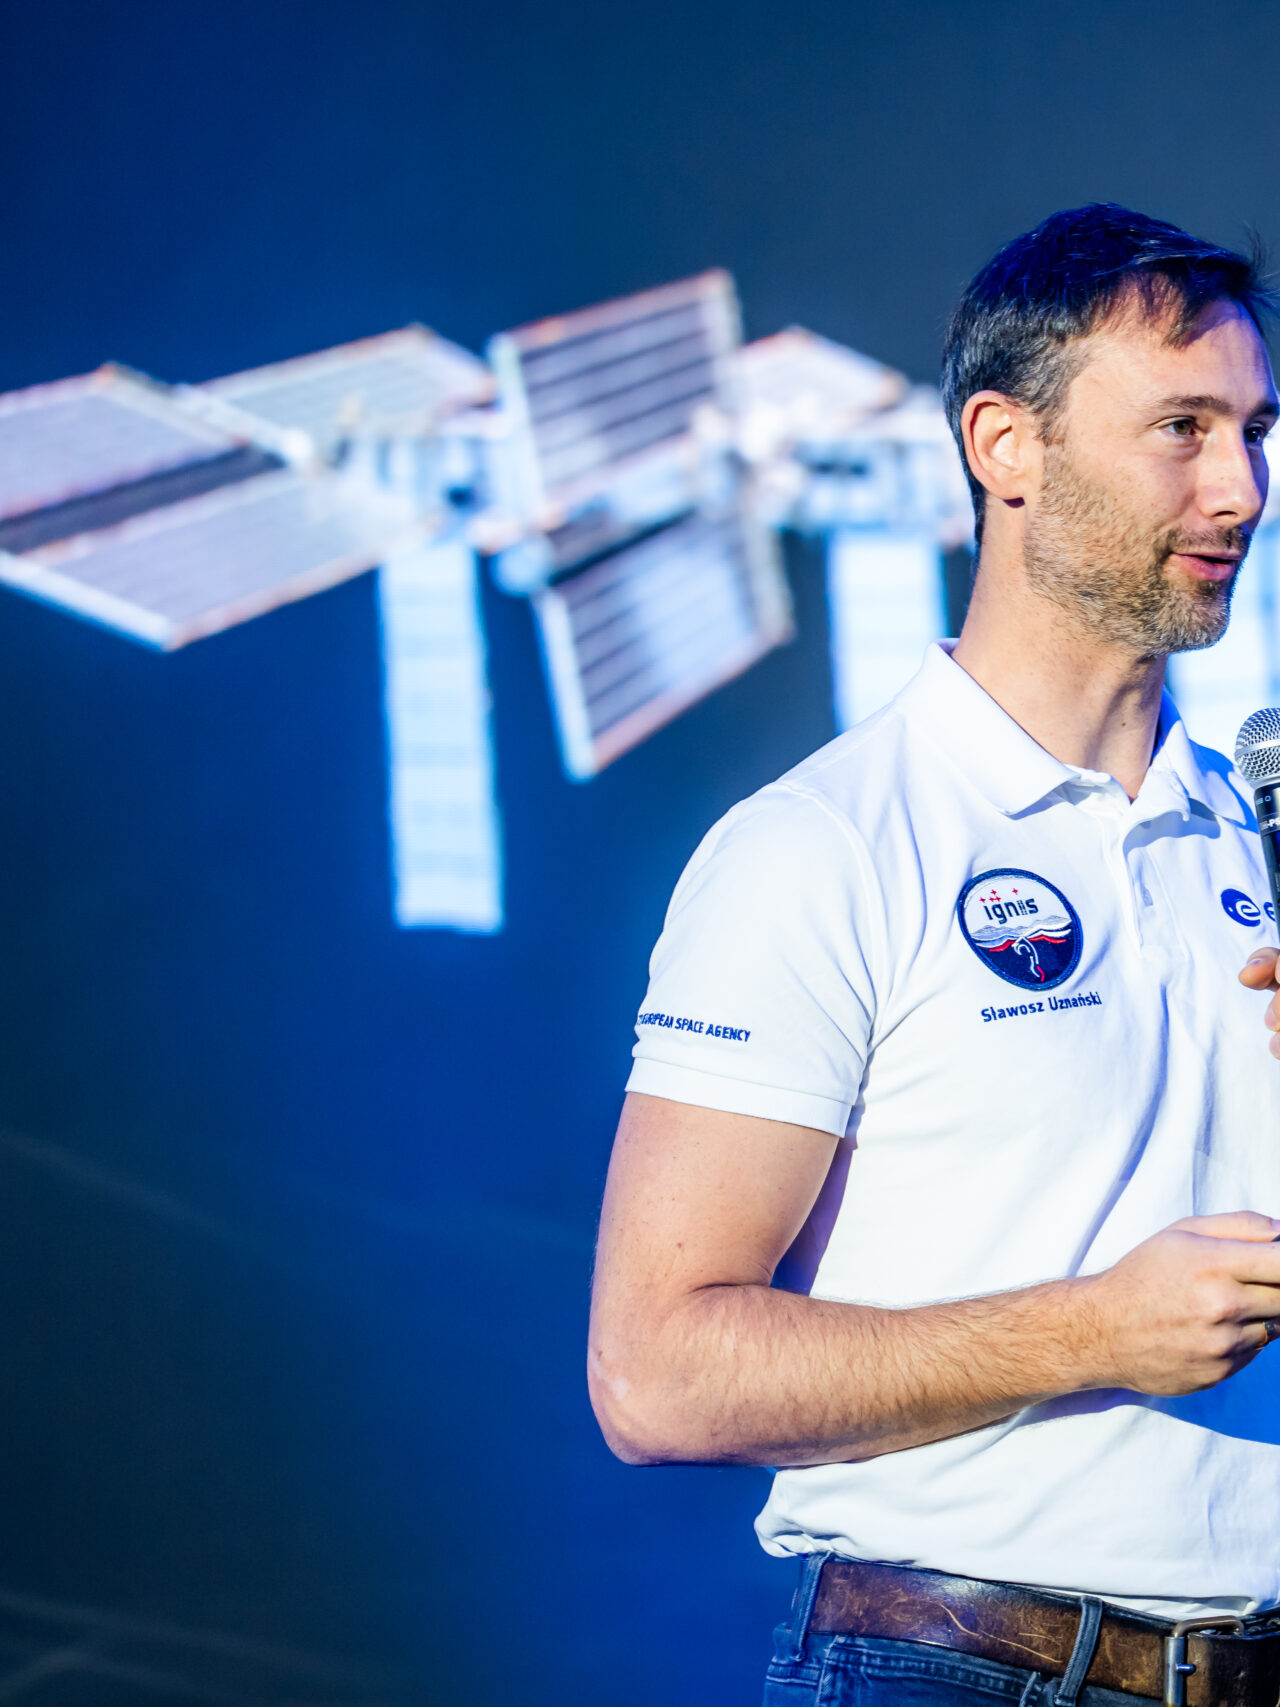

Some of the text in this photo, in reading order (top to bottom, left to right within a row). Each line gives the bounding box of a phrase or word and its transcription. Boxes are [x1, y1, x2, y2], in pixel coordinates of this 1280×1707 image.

[1048, 991, 1103, 1011] Uznański
[674, 1017, 704, 1034] SPACE
[705, 1023, 751, 1043] AGENCY
